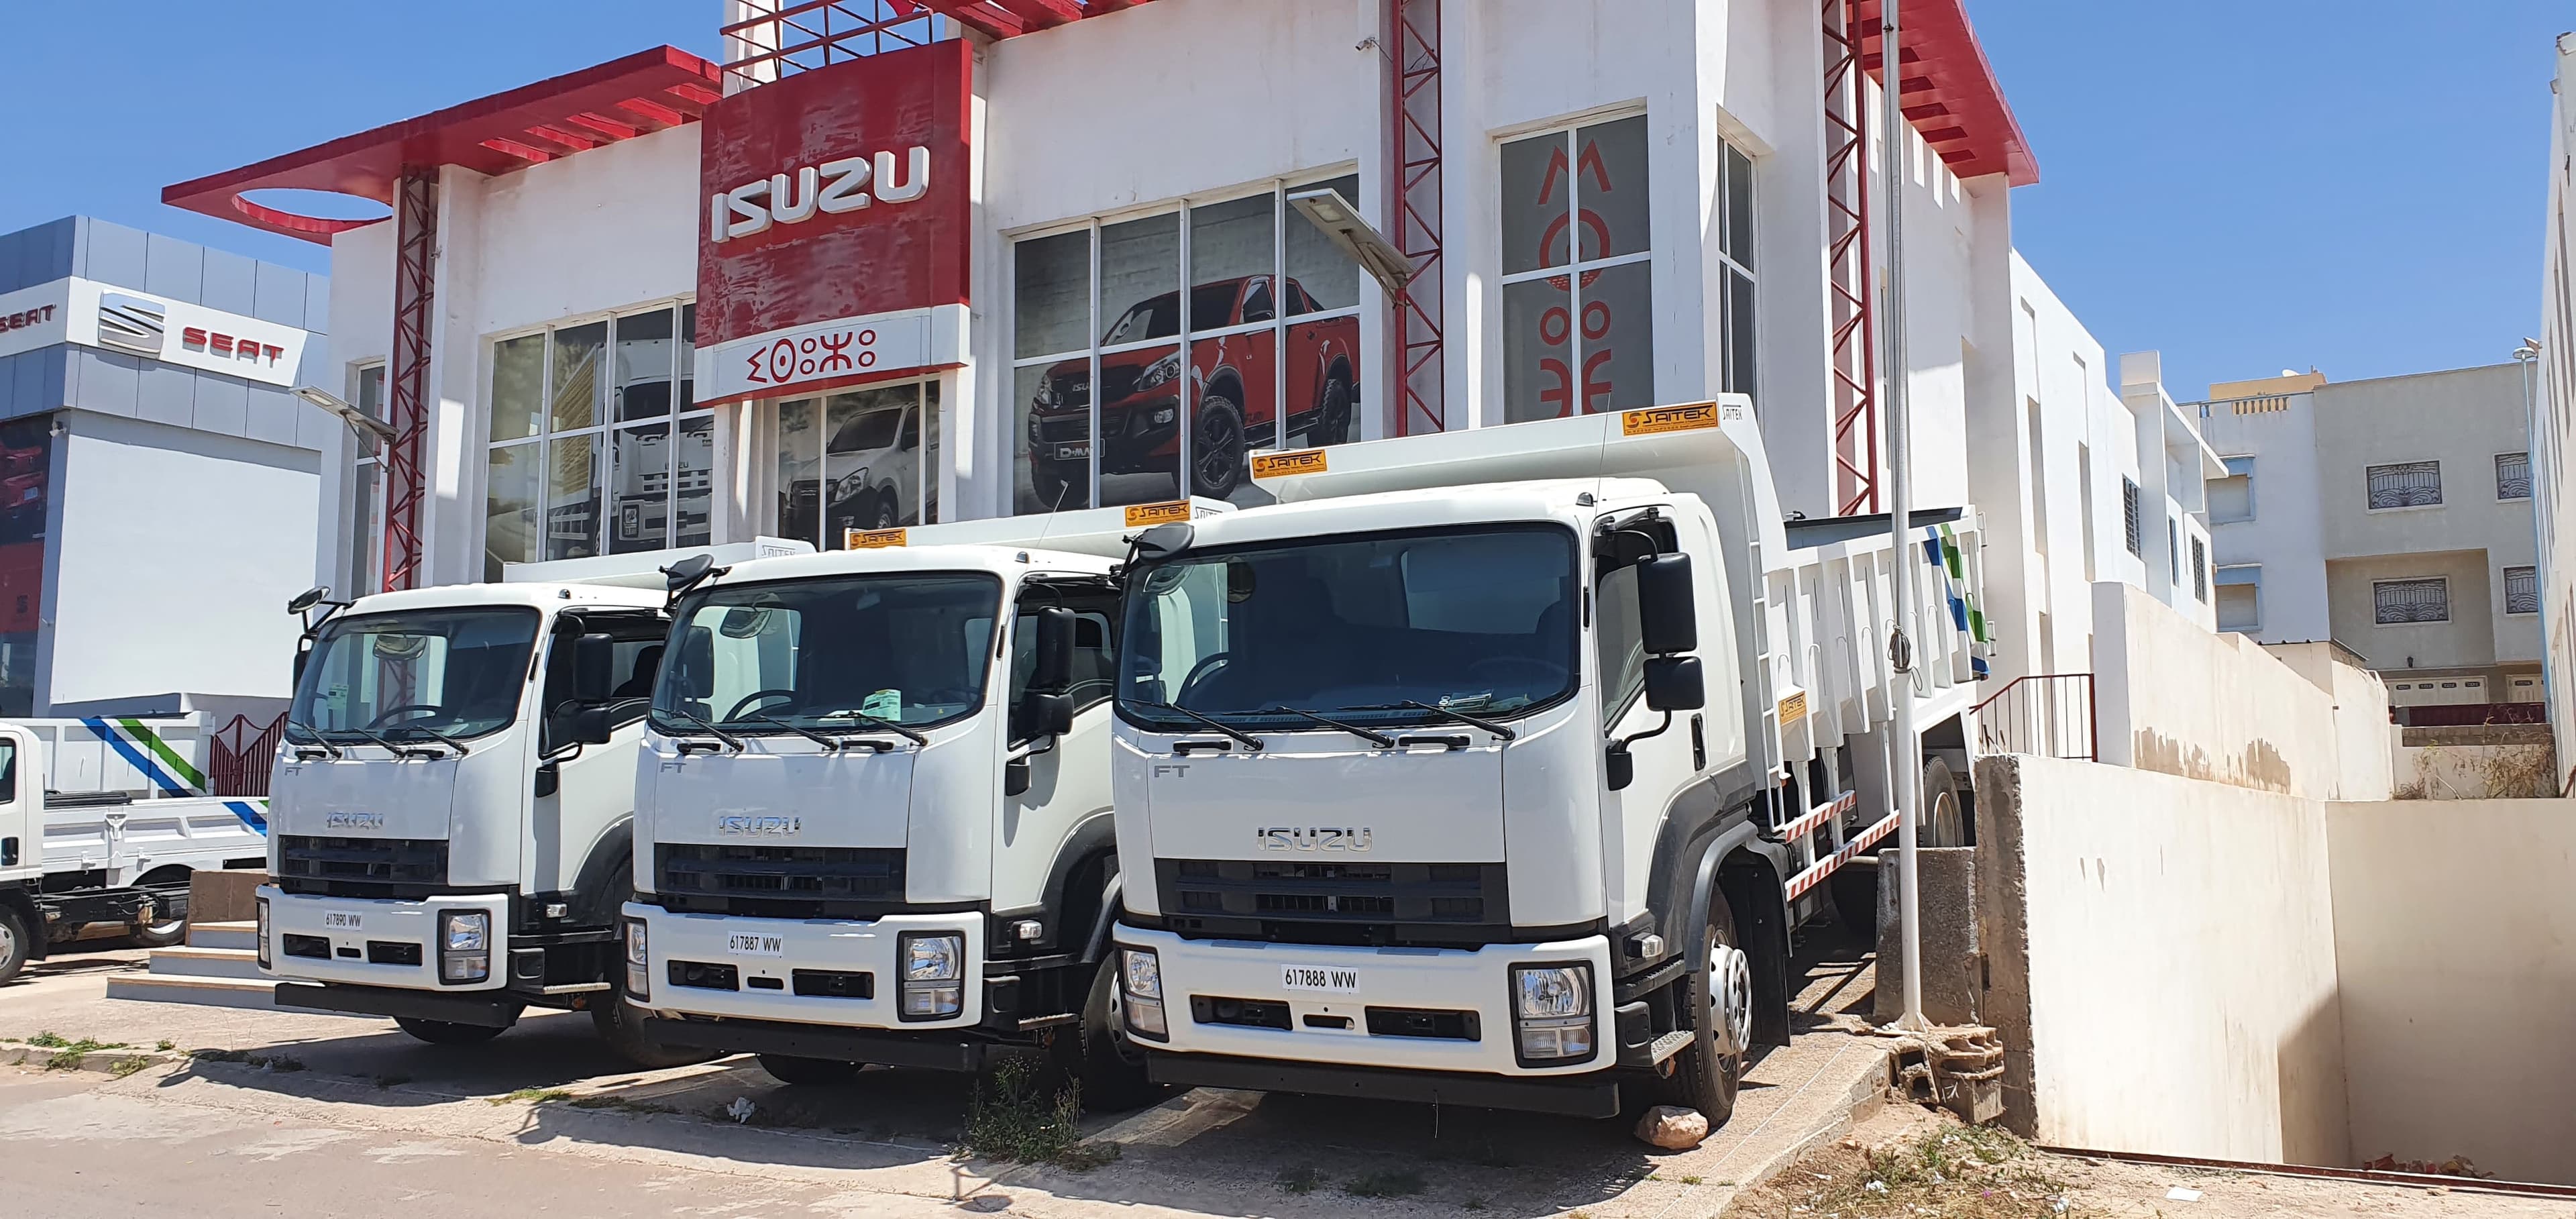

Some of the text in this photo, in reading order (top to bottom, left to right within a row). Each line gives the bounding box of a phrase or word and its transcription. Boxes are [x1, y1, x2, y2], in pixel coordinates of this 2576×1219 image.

[712, 146, 930, 243] ISUZU
[183, 327, 284, 361] SEAT
[1072, 382, 1089, 392] ISU
[1643, 405, 1713, 424] SAITEK
[1722, 405, 1742, 420] SAITEK
[1268, 452, 1322, 468] SAITEK
[1140, 503, 1189, 517] SAITEK
[284, 767, 303, 776] FT
[660, 762, 687, 774] FT
[1154, 765, 1191, 778] FT
[327, 812, 384, 829] ISUZU
[718, 816, 801, 837] ISUZU
[1258, 827, 1373, 852] ISUZU
[326, 913, 361, 927] 617890 WW
[730, 935, 782, 952] 617887 WW
[1285, 969, 1356, 988] 617888 WW
